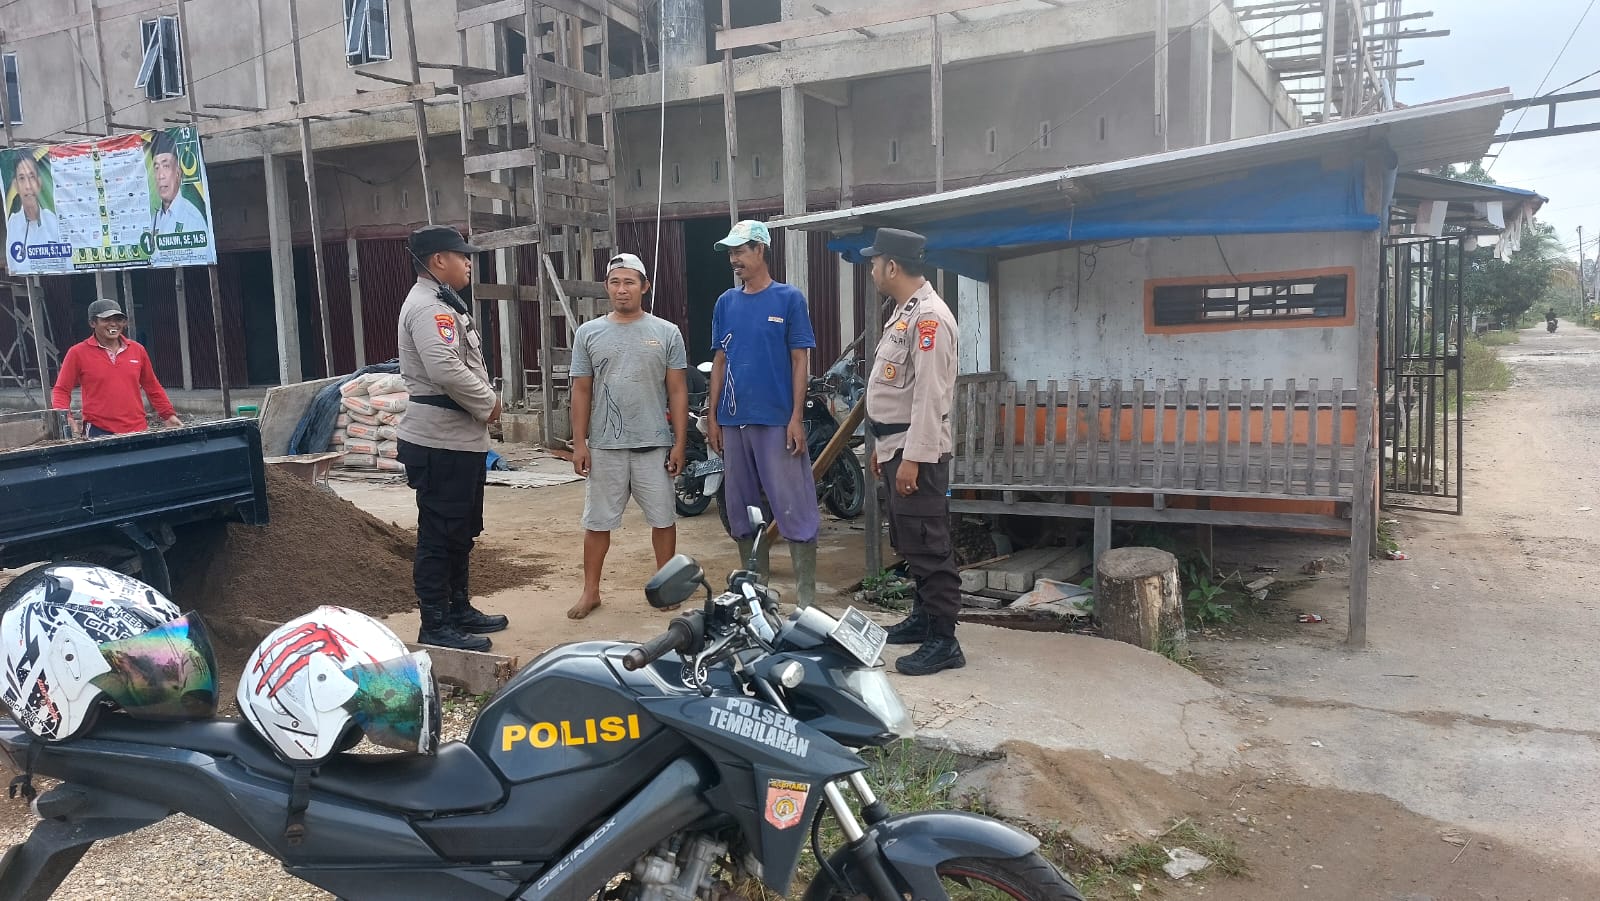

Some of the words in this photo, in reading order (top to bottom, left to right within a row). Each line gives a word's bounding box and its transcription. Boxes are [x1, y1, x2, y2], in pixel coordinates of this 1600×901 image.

[181, 127, 190, 140] 13
[14, 244, 23, 260] 2
[144, 235, 151, 252] 1
[727, 697, 799, 734] POLSEK
[501, 713, 641, 752] POLISI
[708, 706, 810, 758] TEMBILAHAN
